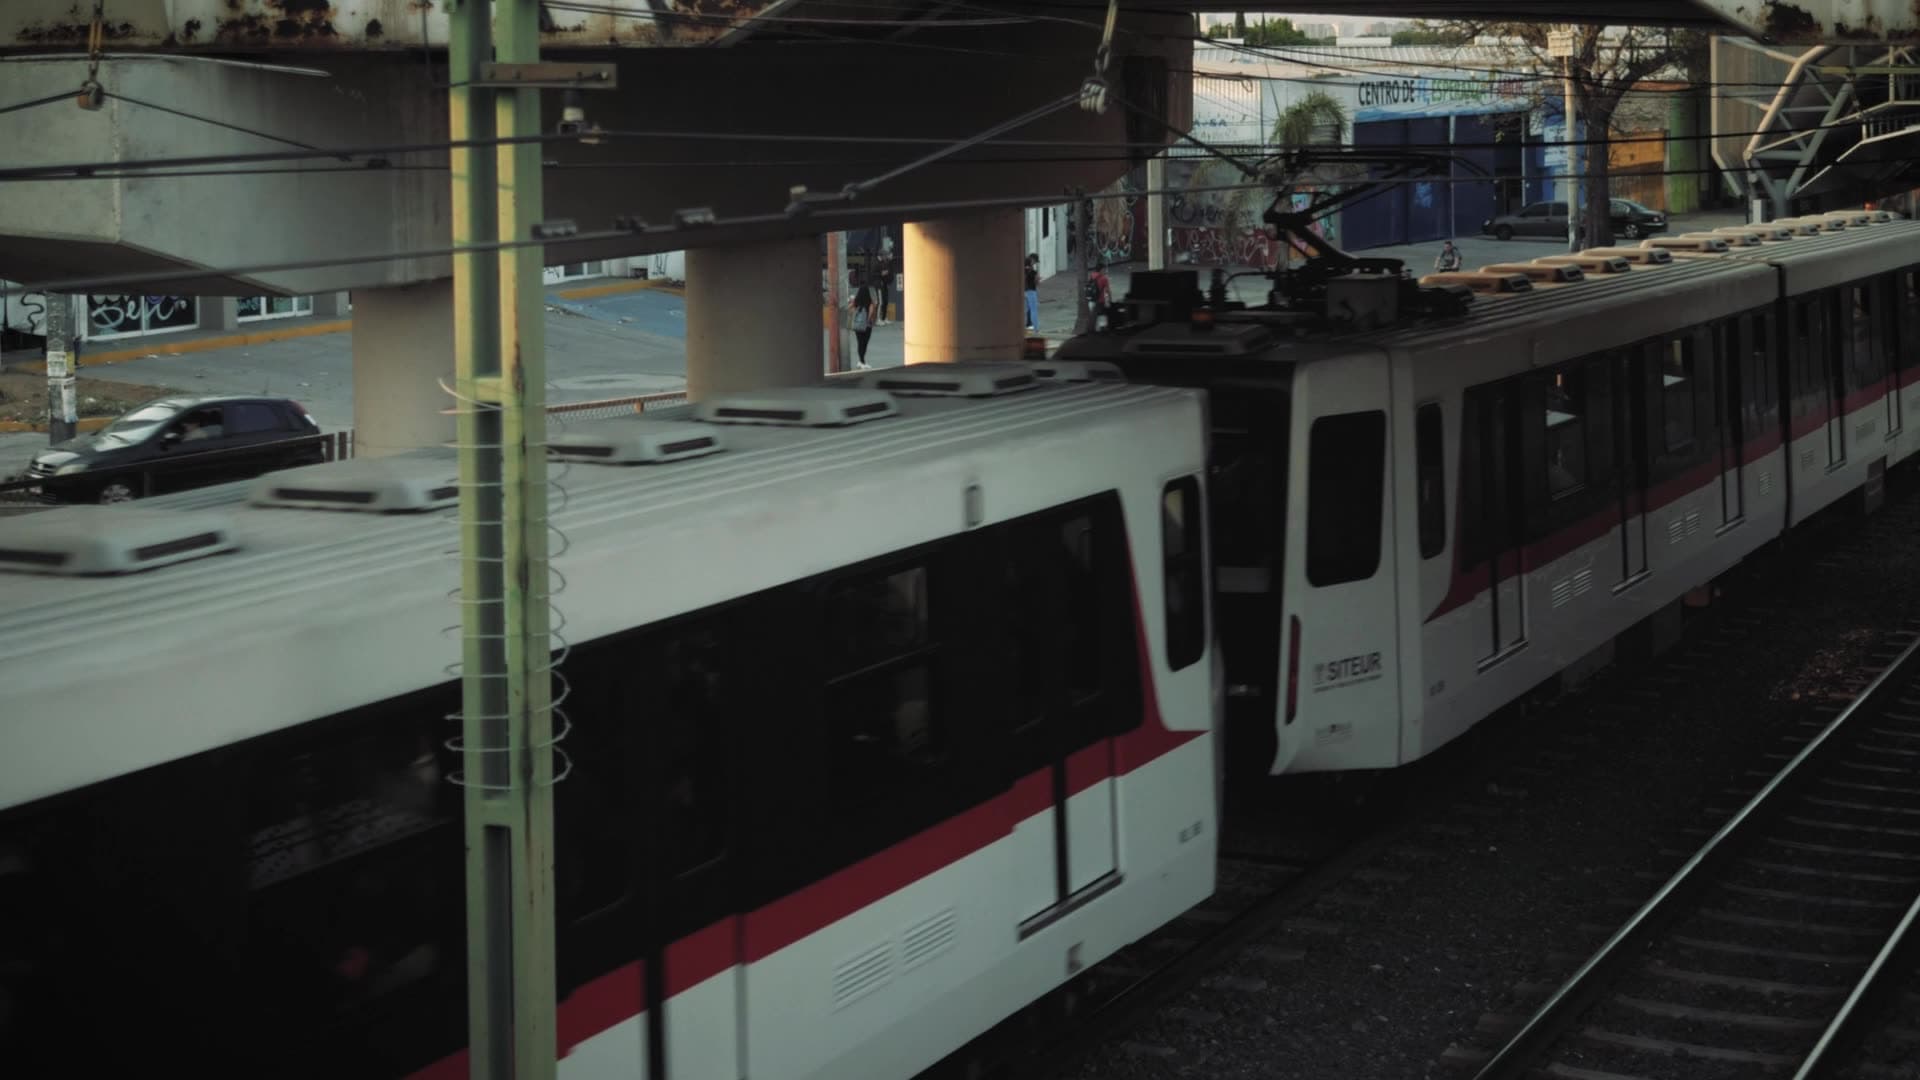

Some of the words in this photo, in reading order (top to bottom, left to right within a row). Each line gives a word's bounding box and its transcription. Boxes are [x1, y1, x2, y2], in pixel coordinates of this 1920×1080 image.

[1358, 80, 1400, 105] CENTRO
[1402, 80, 1415, 103] DE
[1328, 651, 1382, 681] SITEUR
